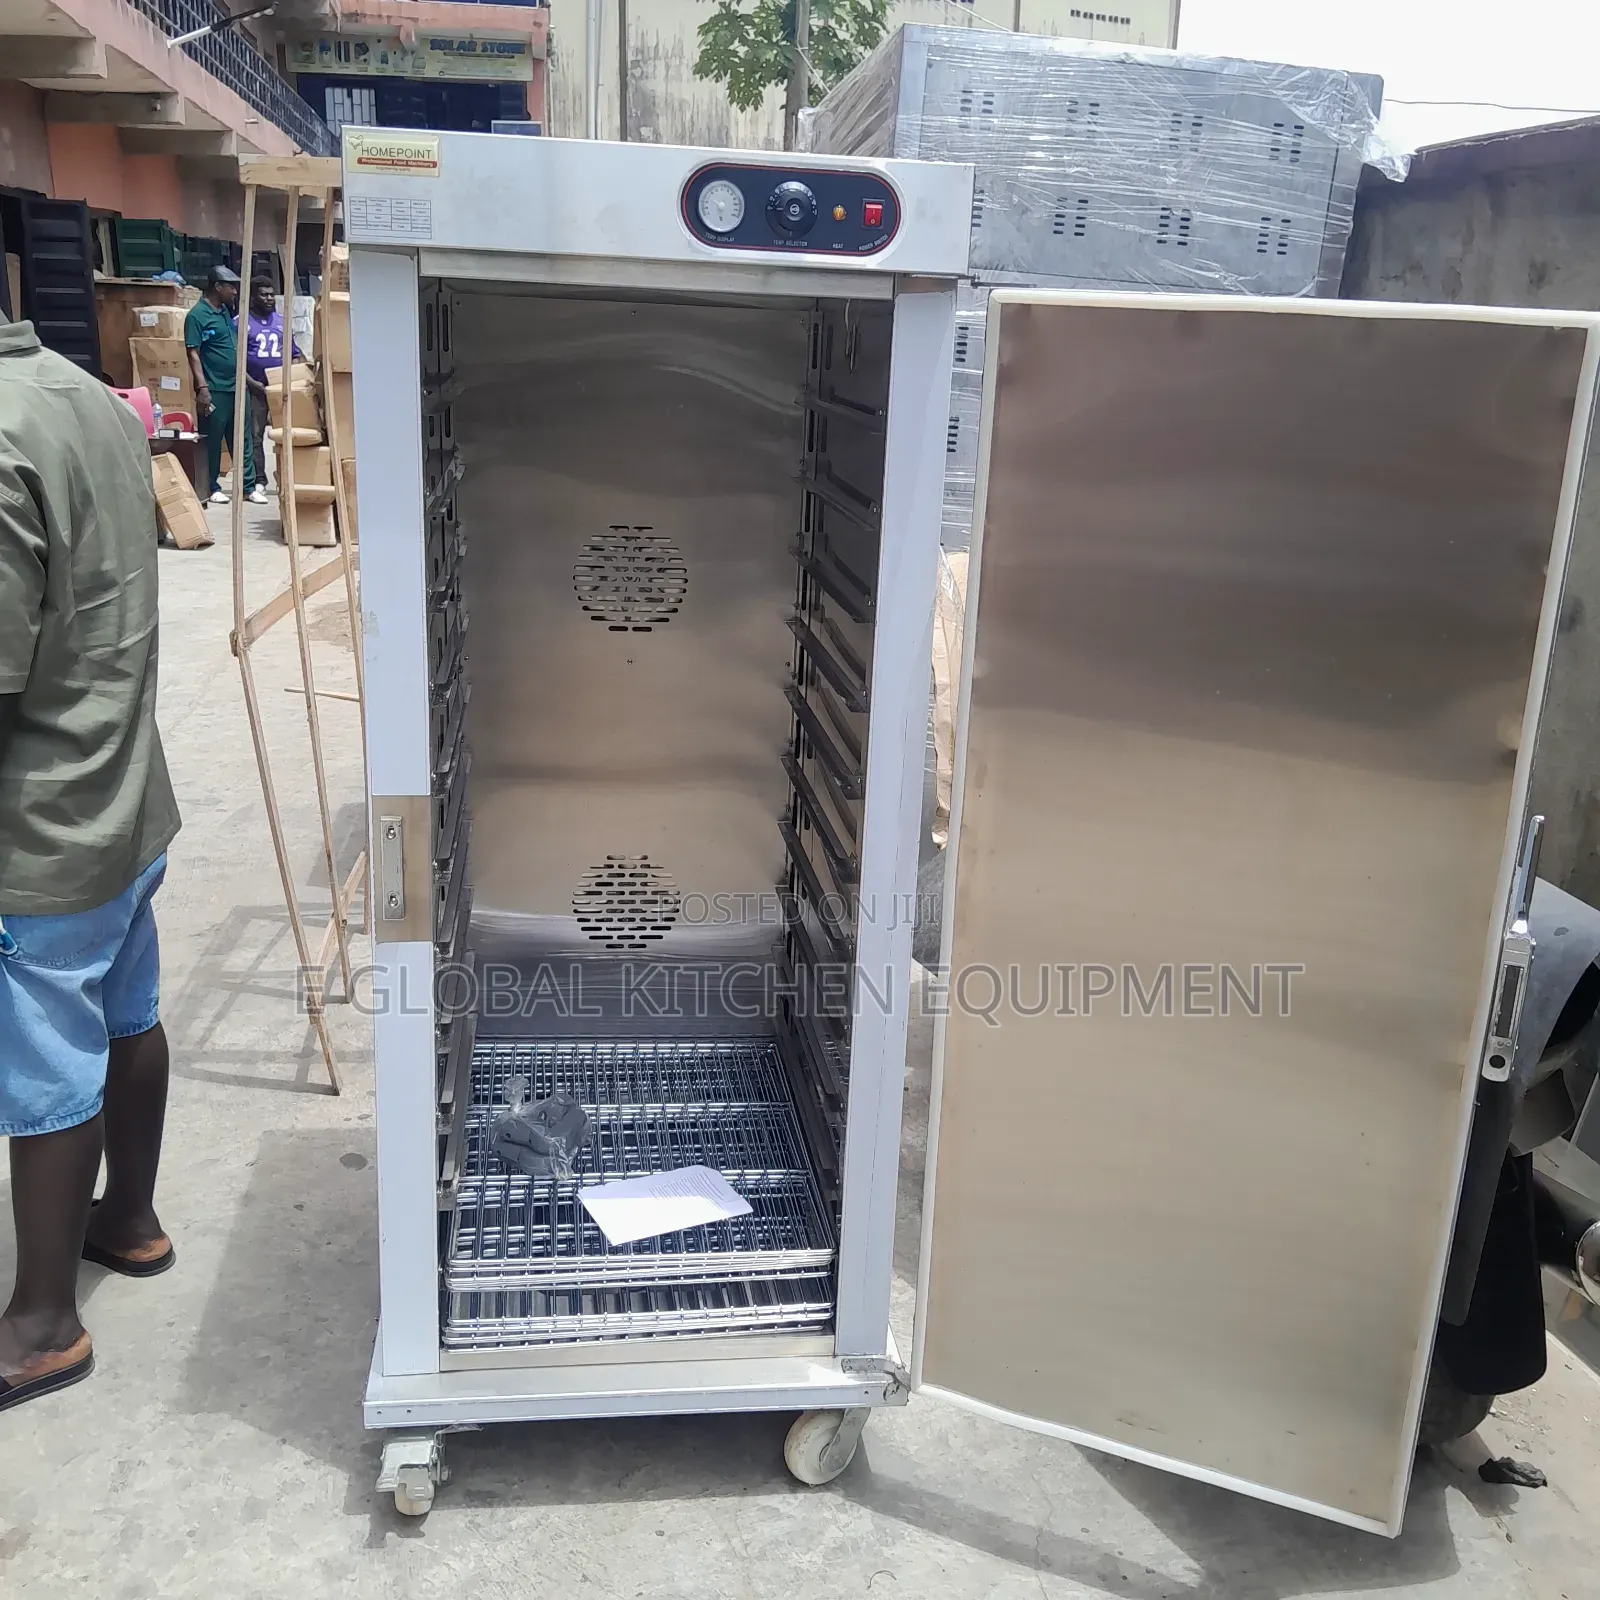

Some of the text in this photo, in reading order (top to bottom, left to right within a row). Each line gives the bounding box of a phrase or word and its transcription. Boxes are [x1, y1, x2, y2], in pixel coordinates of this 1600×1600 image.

[429, 38, 478, 53] SOLAR
[361, 146, 432, 159] HOMEPOINT
[407, 160, 434, 168] Machinery
[717, 235, 735, 243] DISPLAY
[785, 240, 808, 248] SELECTOR
[255, 333, 282, 358] 22
